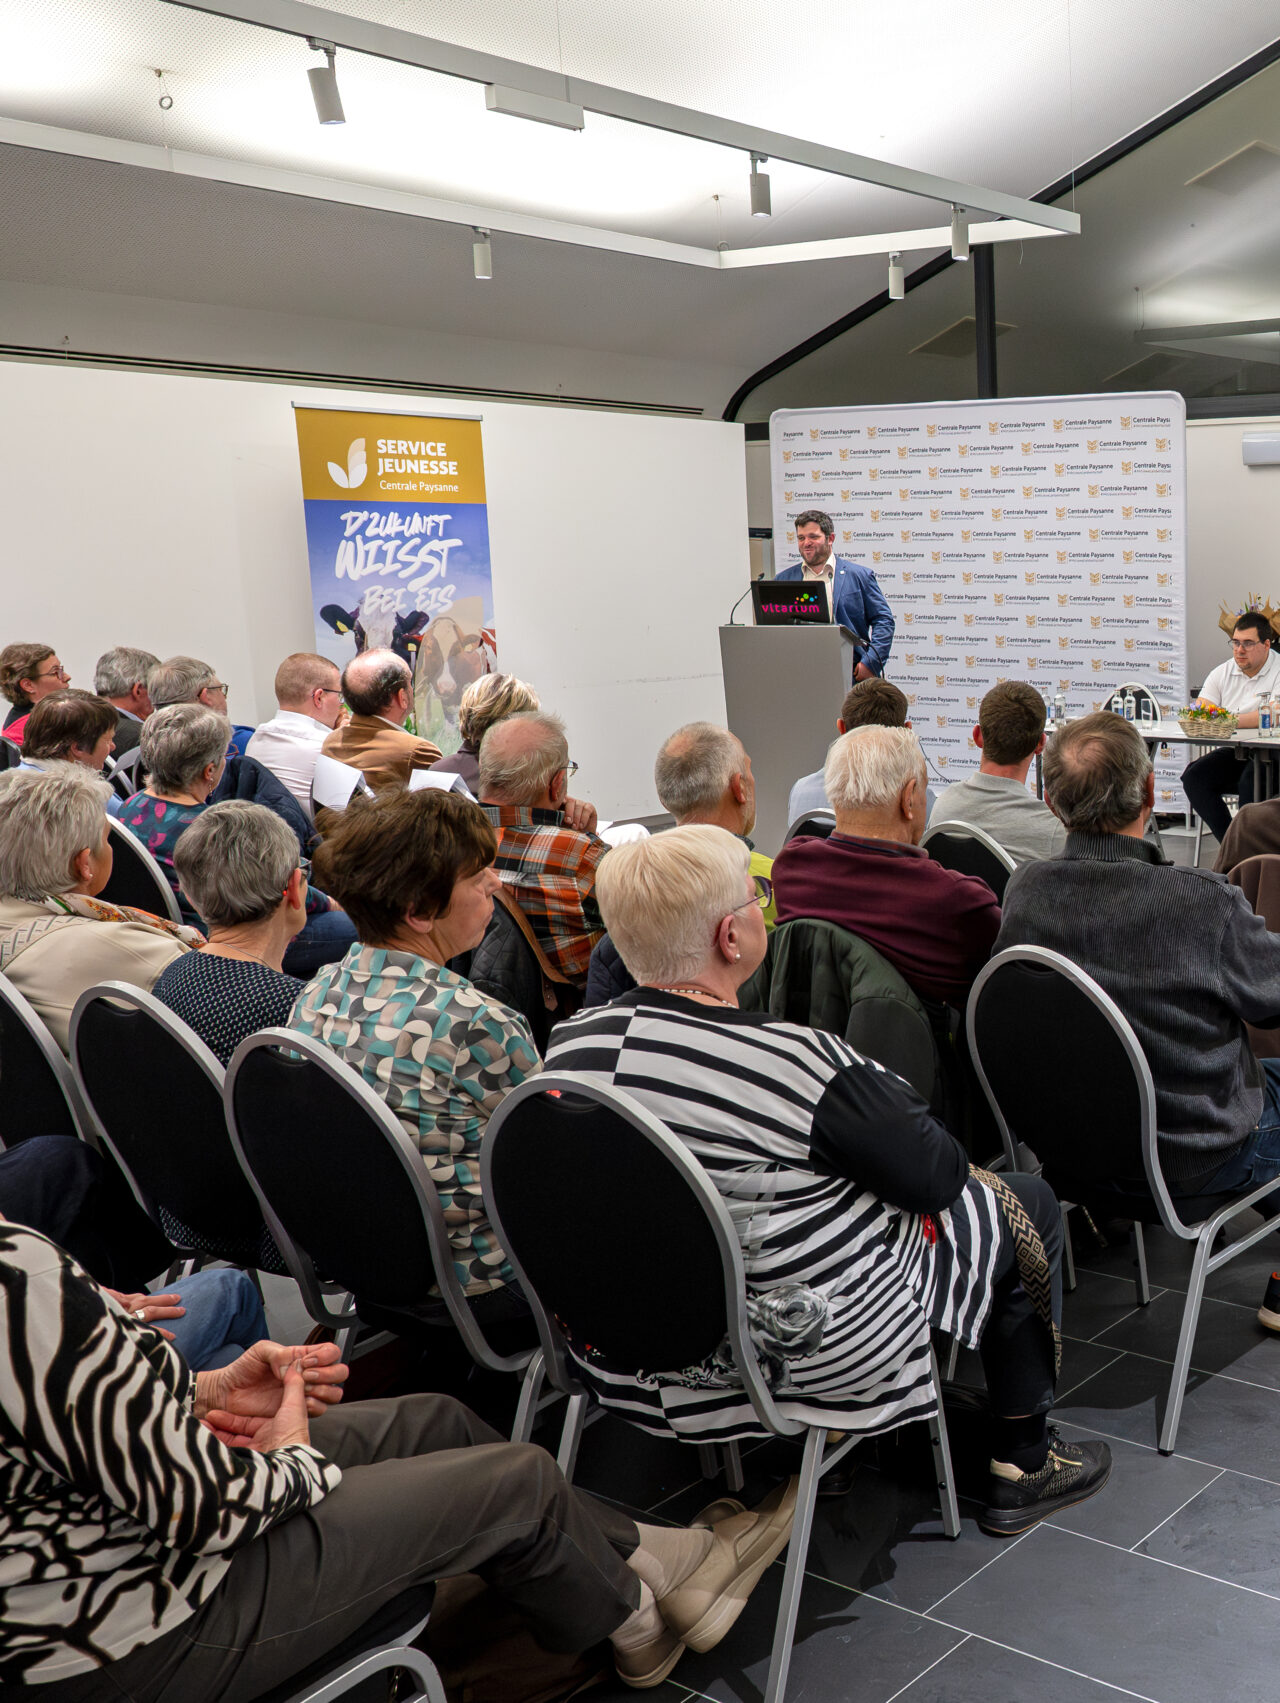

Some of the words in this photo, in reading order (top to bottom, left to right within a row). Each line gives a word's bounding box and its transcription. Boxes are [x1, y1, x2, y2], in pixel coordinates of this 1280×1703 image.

[376, 439, 447, 456] SERVICE
[377, 458, 458, 476] JEUNESSE
[379, 480, 417, 491] Centrale
[419, 481, 459, 493] Paysanne
[340, 510, 452, 538] D'ZUKUNFT
[335, 534, 464, 592] WIISST
[363, 584, 407, 616] BEI
[415, 584, 457, 614] EIS
[762, 601, 820, 613] vitarium
